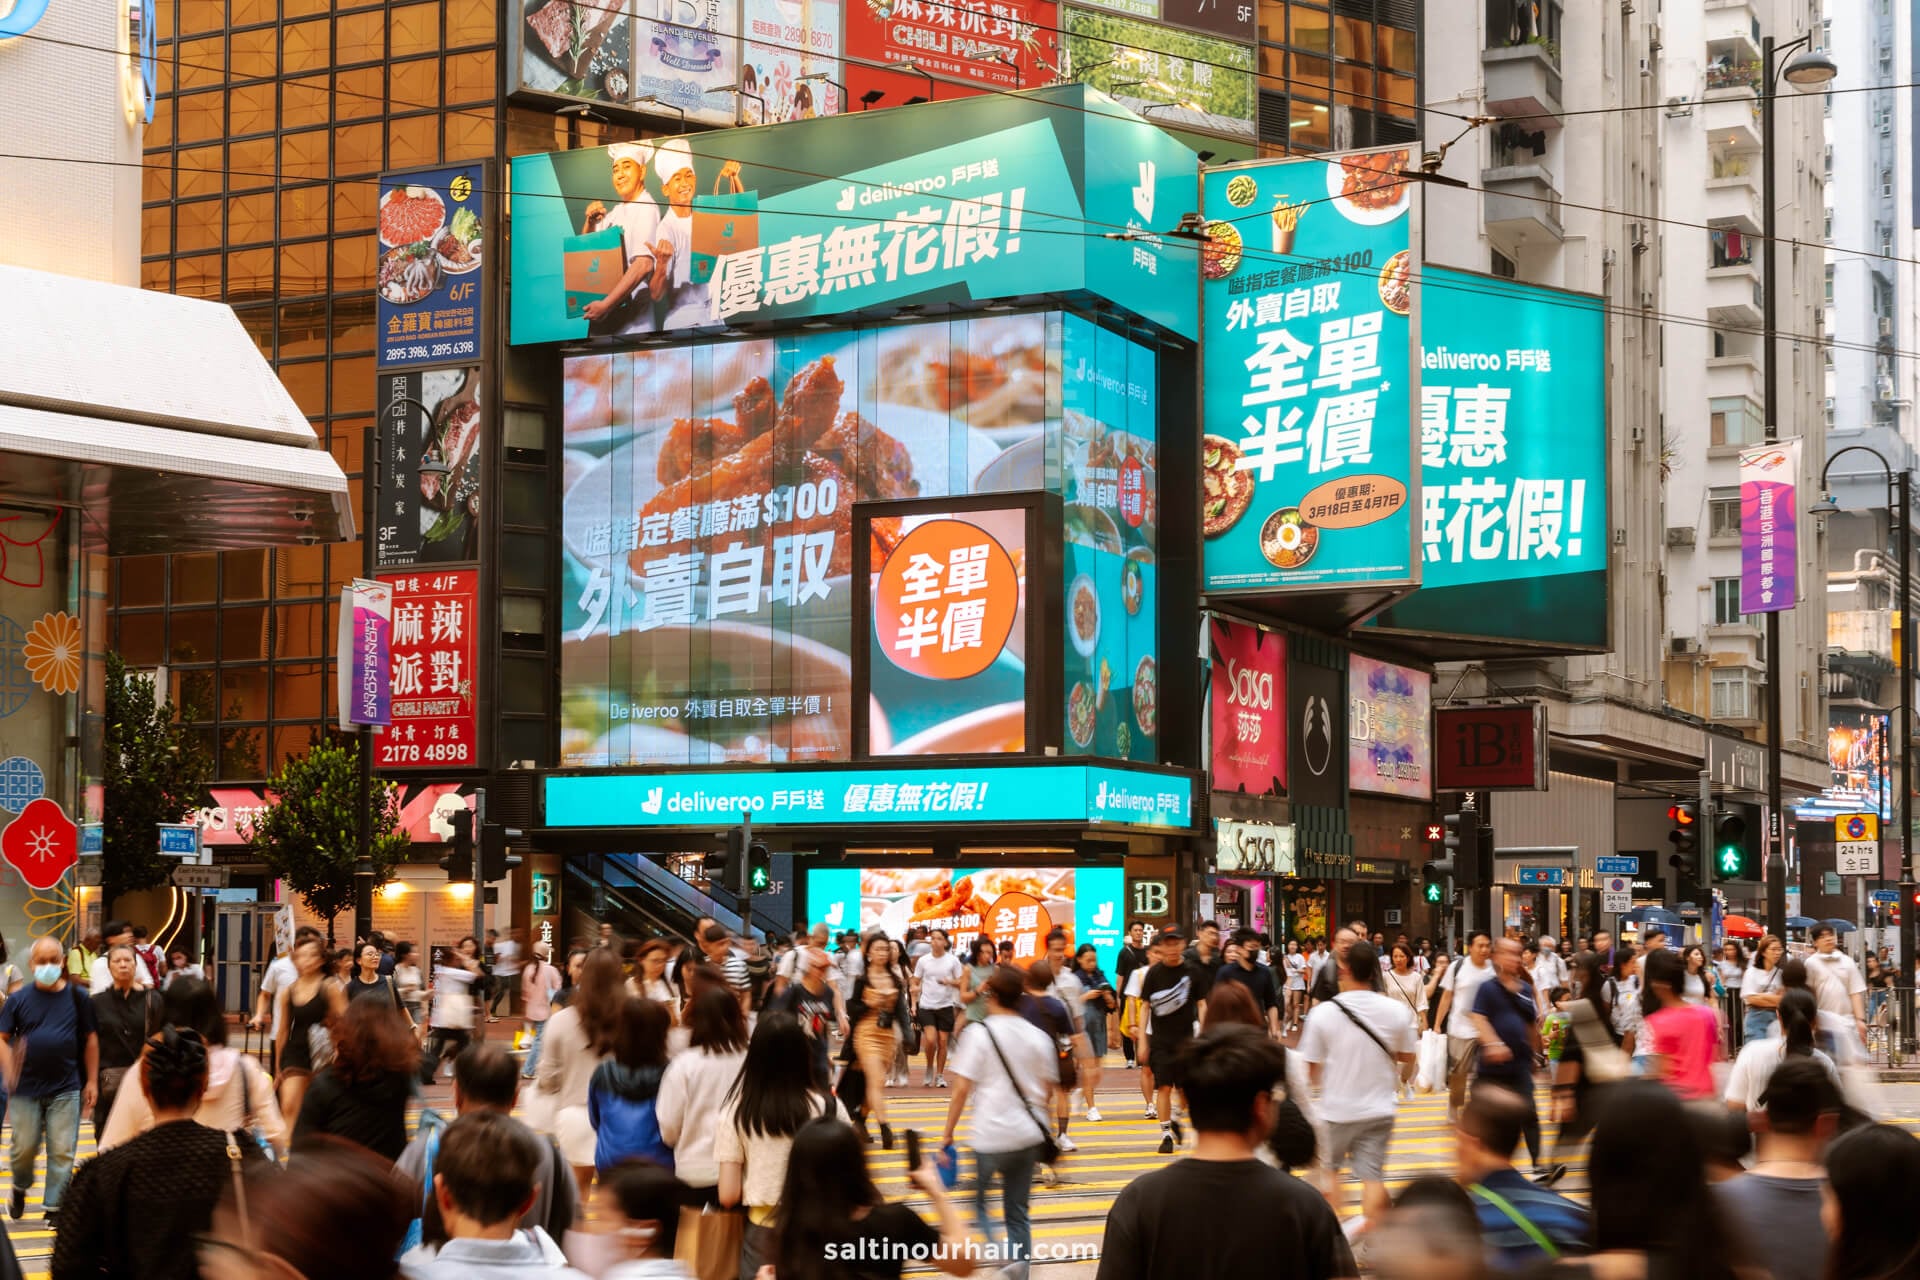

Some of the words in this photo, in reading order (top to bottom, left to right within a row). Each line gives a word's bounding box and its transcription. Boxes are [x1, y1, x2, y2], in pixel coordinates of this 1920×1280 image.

[1237, 5, 1252, 23] 5F
[784, 25, 806, 45] 2890
[810, 30, 833, 49] 6870
[662, 52, 680, 67] Well
[859, 172, 946, 207] deliveroo
[952, 157, 1000, 186] 戶戶送
[708, 186, 1026, 320] 優惠無花假!
[1228, 249, 1373, 296] 嗌指定餐廳滿$100
[450, 282, 475, 302] 6/F
[1225, 281, 1342, 332] 外賣自取
[387, 311, 432, 334] 金羅寶
[386, 348, 406, 360] 2895
[432, 344, 452, 356] 2895
[452, 341, 474, 354] 6398
[1242, 310, 1383, 407] 全單
[1506, 349, 1552, 372] 戶戶送
[1308, 492, 1399, 520] 3月18日至4月7日
[379, 526, 398, 541] 3F
[432, 576, 458, 590] 4/F
[576, 530, 836, 642] 外賣自取
[900, 544, 990, 604] 全單
[392, 600, 464, 646] 麻辣
[894, 598, 987, 658] 半價
[366, 618, 378, 667] HONG
[389, 650, 462, 696] 派對
[366, 670, 378, 718] KONG
[423, 700, 460, 715] PARTY
[610, 703, 678, 720] Deiveroo
[392, 724, 416, 742] 外賣
[1237, 711, 1262, 744] 莎莎
[382, 745, 420, 762] 2178
[424, 744, 468, 762] 4898
[667, 790, 765, 812] deliveroo
[770, 789, 825, 811] 戶戶送
[843, 782, 989, 814] 優惠無花假!
[1108, 786, 1154, 812] deliveroo
[1324, 854, 1337, 865] BODY
[1841, 845, 1854, 856] 24
[1857, 845, 1873, 856] hrs
[1845, 858, 1871, 872] 全日
[1134, 881, 1169, 915] iB
[996, 905, 1039, 932] 全單
